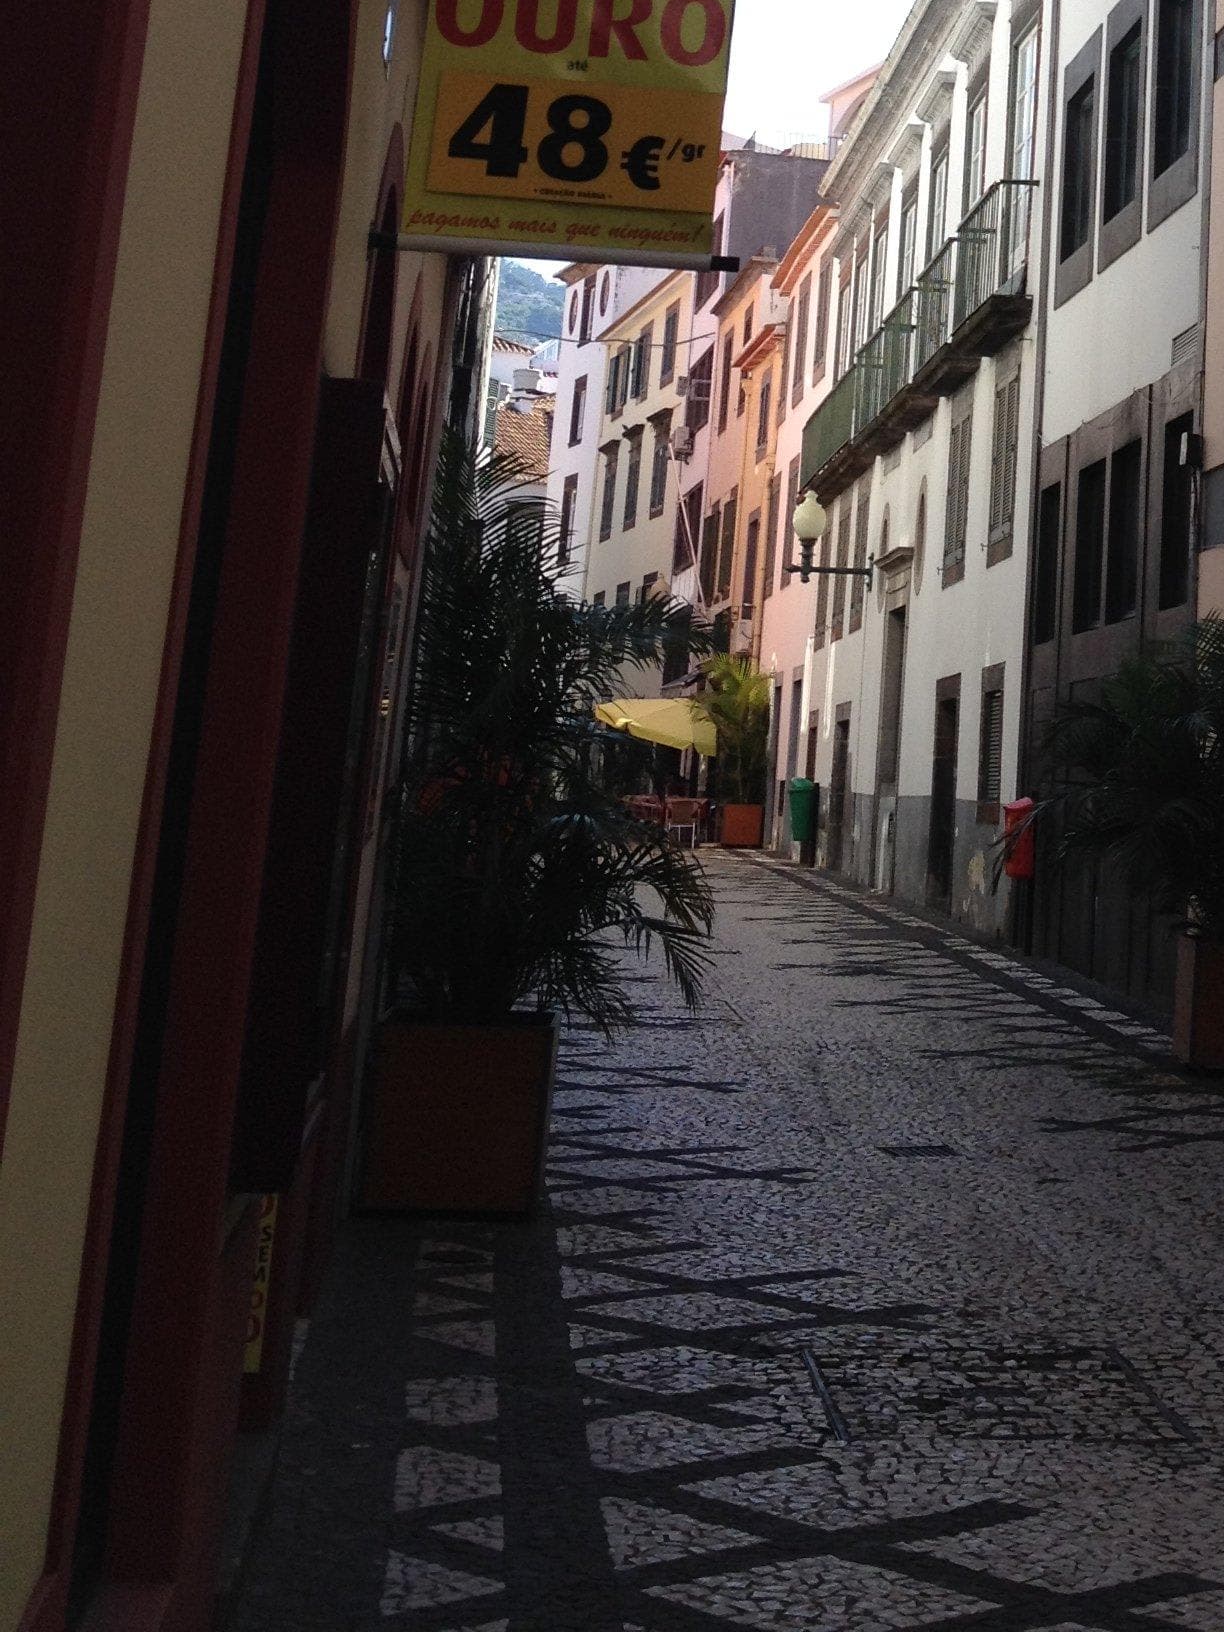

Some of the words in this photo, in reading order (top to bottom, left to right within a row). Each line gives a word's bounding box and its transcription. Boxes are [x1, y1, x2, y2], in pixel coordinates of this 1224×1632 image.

[406, 209, 501, 233] pagamos
[508, 219, 557, 234] mais
[565, 223, 601, 241] que
